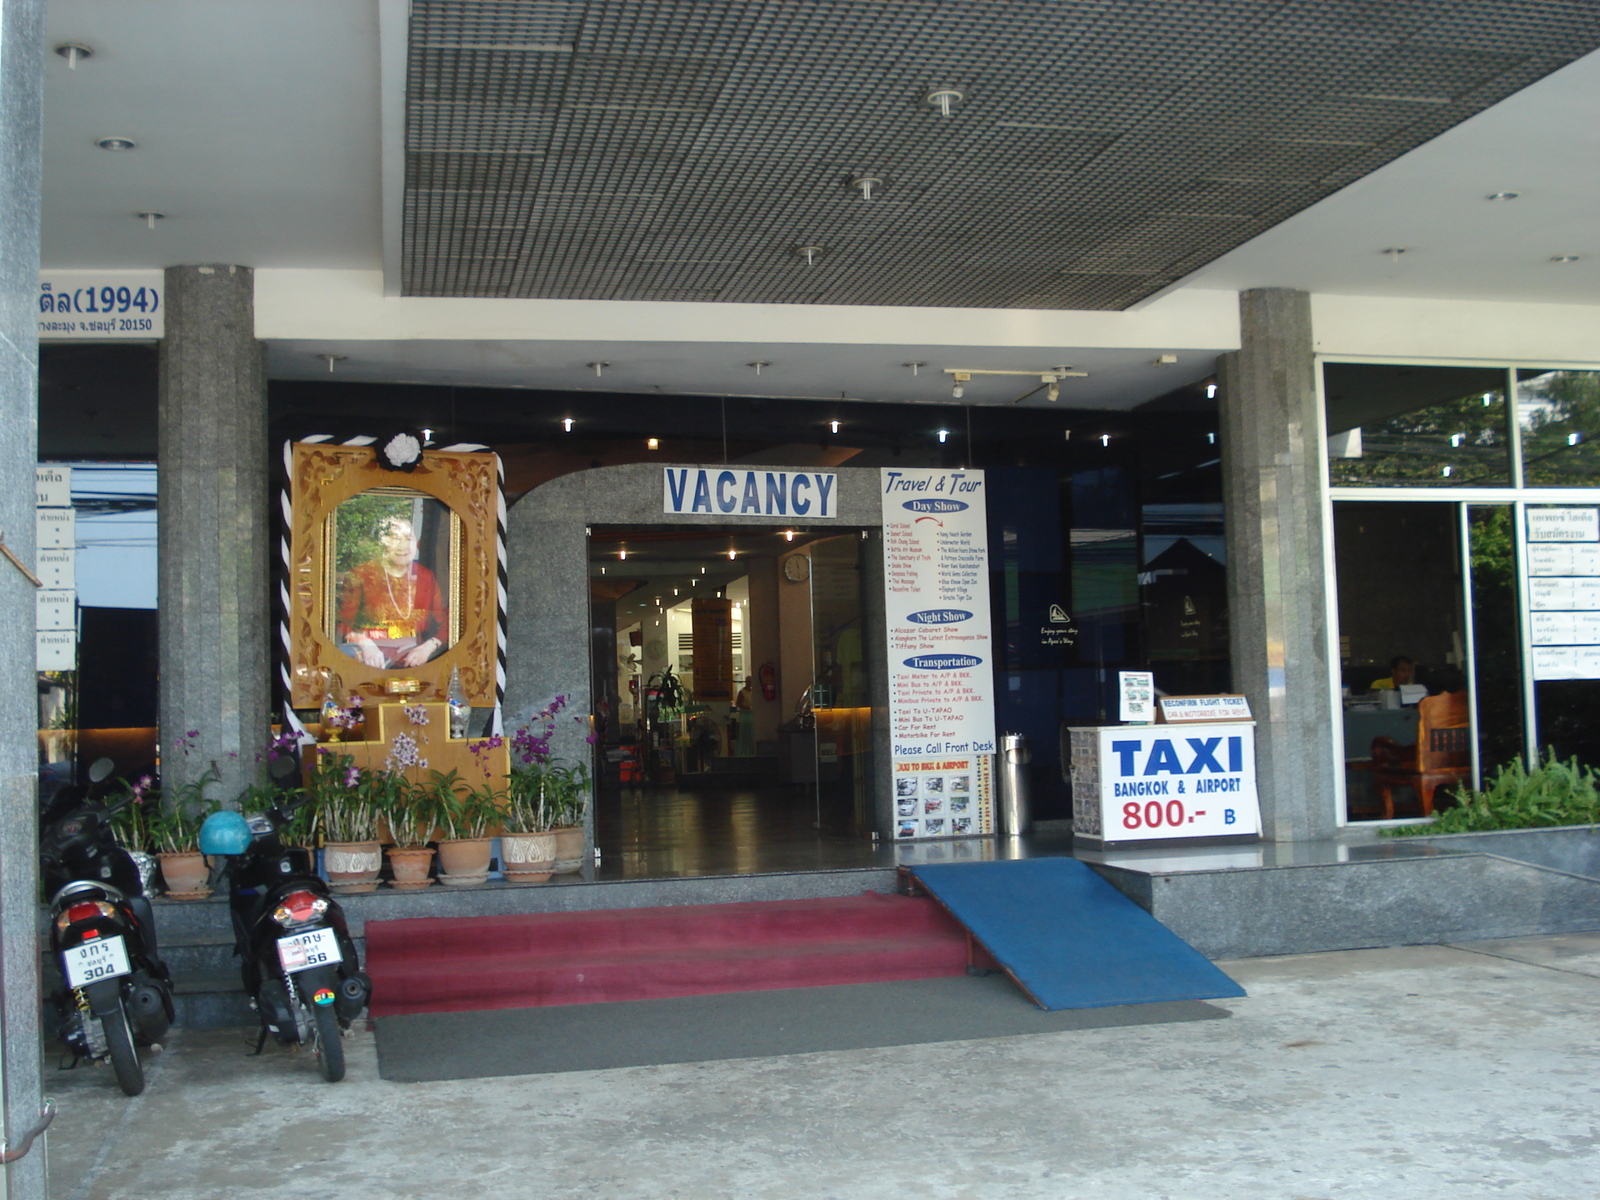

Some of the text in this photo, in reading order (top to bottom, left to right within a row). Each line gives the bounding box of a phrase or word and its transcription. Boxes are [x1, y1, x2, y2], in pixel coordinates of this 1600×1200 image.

[119, 318, 152, 330] 20150
[886, 472, 982, 495] Travel & Tour
[666, 469, 834, 516] VACANCY
[912, 501, 960, 513] Day Show
[916, 612, 966, 624] Night Show
[912, 656, 977, 669] Transportation
[1163, 698, 1244, 707] RECONFIRM FLIGHT TICKET
[1232, 708, 1246, 716] RENT
[894, 740, 994, 755] Please Call Front Desk
[1112, 736, 1243, 777] TAXI
[911, 763, 920, 772] TO
[936, 762, 940, 770] &
[942, 761, 969, 770] AIRPORT
[1114, 778, 1241, 797] BANGKOK & AIRPORT
[1122, 800, 1206, 829] 800.-
[300, 952, 327, 966] 56
[84, 964, 115, 980] 304
